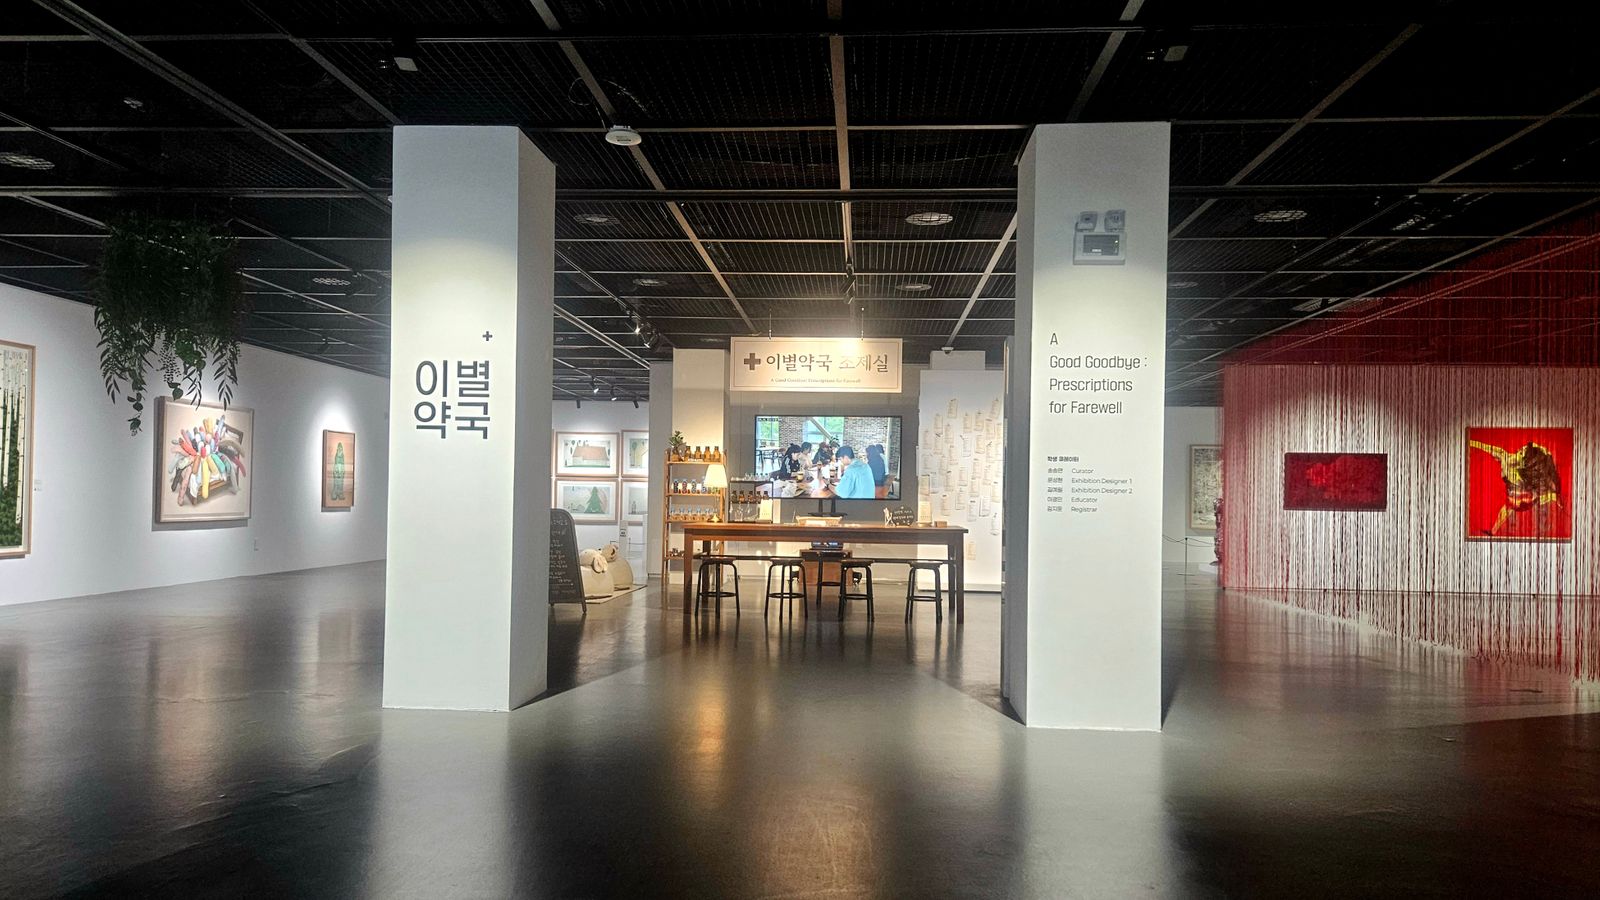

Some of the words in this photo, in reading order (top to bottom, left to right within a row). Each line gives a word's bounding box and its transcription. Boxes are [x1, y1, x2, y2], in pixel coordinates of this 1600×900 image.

[1049, 332, 1059, 345] A
[766, 353, 833, 372] 이별약국
[1049, 355, 1081, 369] Good
[1085, 355, 1141, 370] Goodbye
[415, 359, 490, 398] 이별
[1049, 378, 1133, 392] Prescriptions
[1049, 401, 1067, 413] for
[1071, 401, 1122, 414] Farewell
[413, 401, 491, 440] 약국
[1101, 487, 1128, 495] Designer
